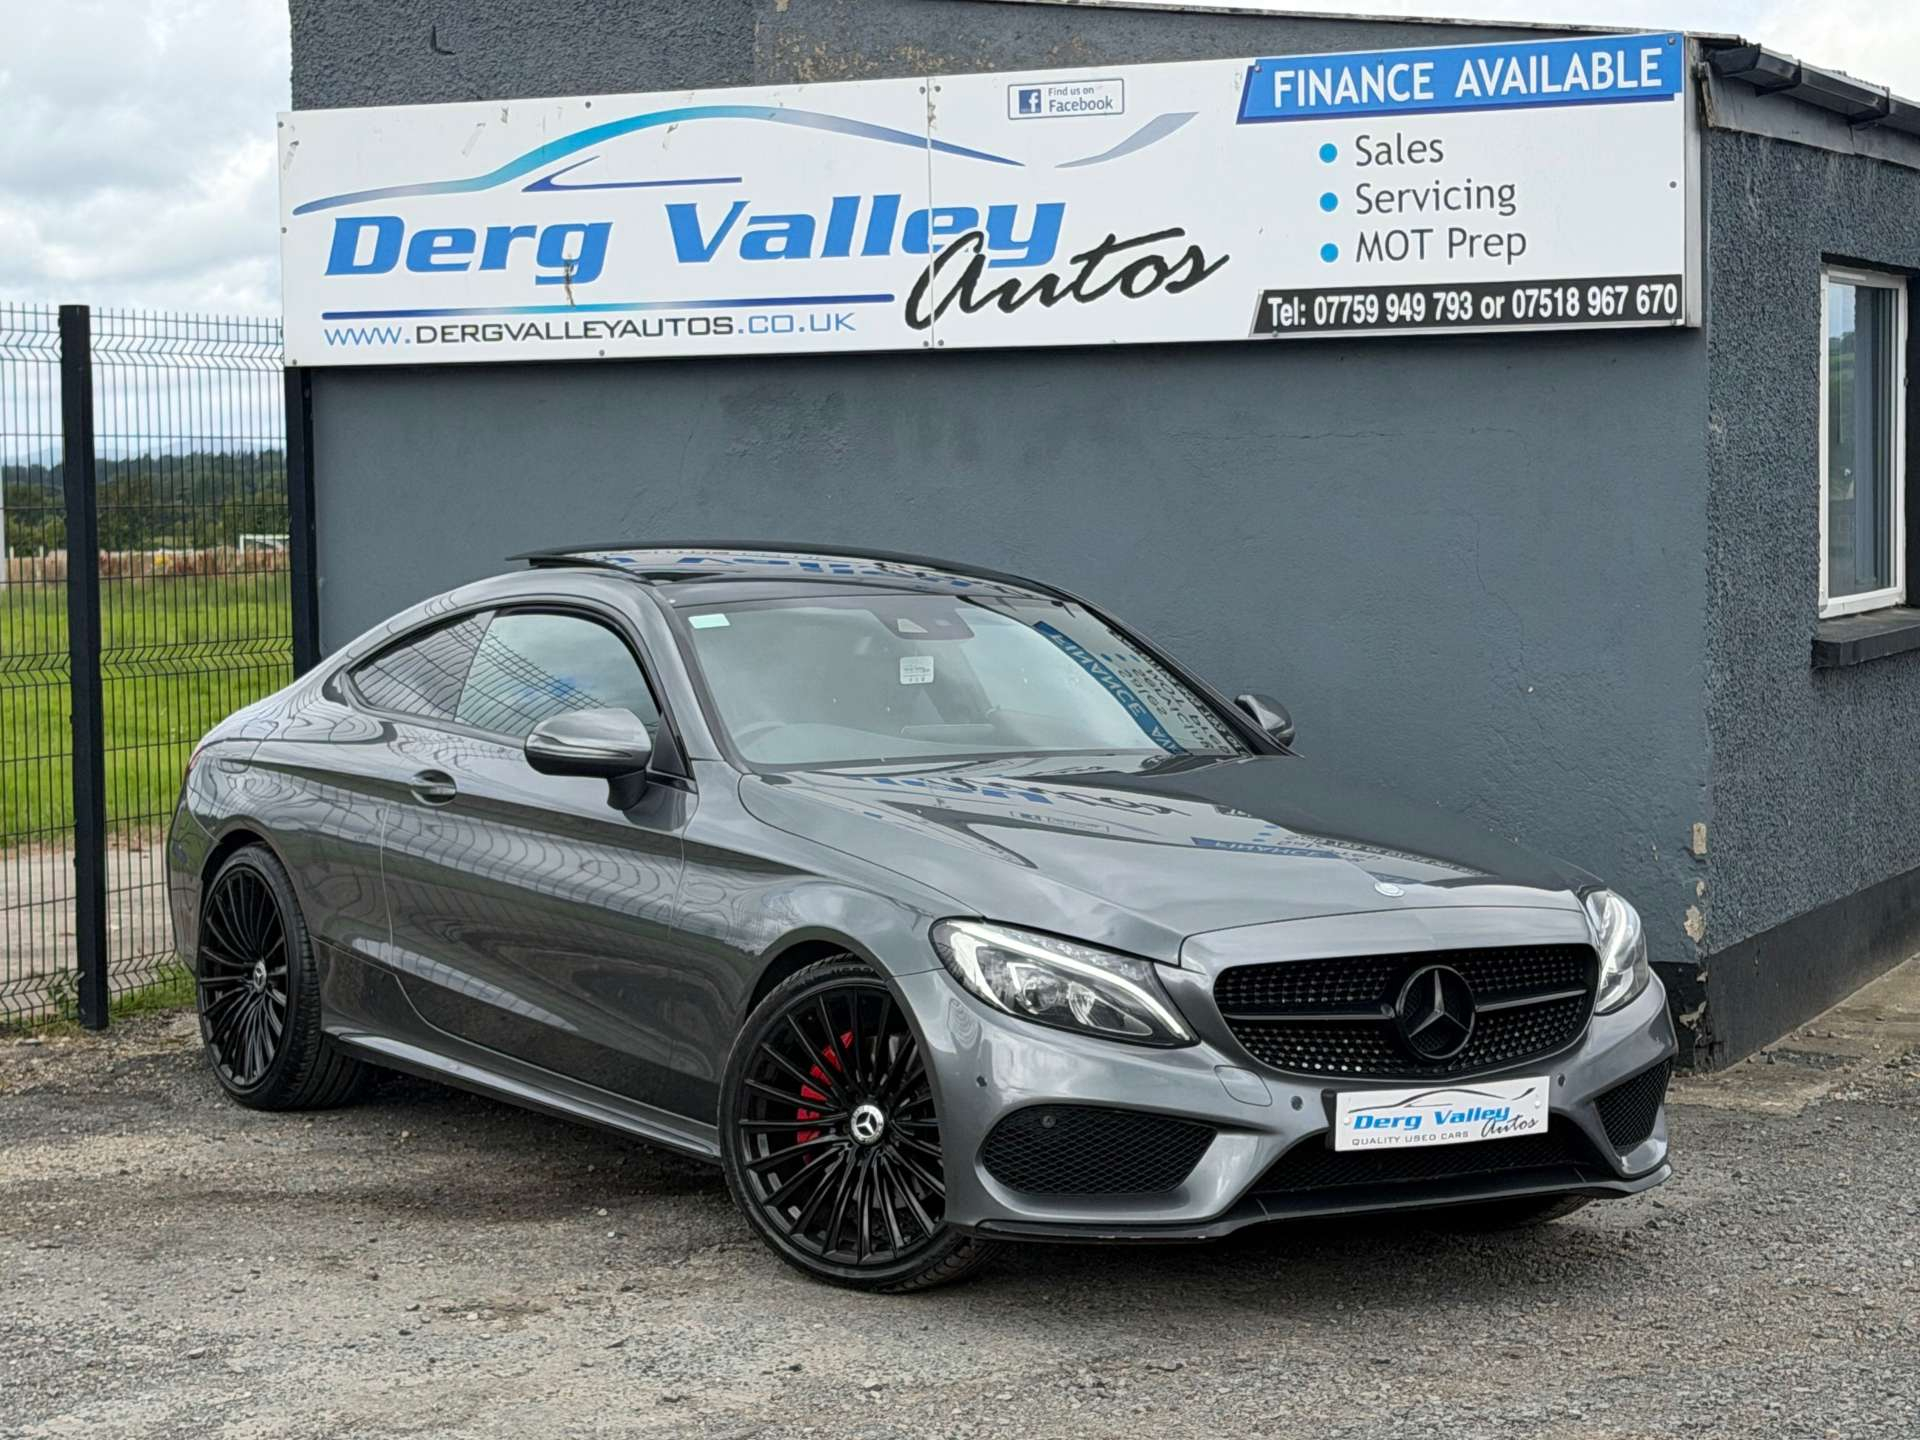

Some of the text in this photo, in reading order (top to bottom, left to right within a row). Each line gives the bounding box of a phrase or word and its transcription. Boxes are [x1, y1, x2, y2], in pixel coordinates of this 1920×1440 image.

[1048, 87, 1068, 96] Find
[1273, 48, 1663, 107] FINANCE AVAILABLE
[1049, 96, 1113, 112] Facebook
[1355, 132, 1444, 167] Sales
[1355, 178, 1517, 216] Servicing
[324, 194, 1066, 285] Derg Valley
[1355, 227, 1527, 265] MOT Prep
[904, 227, 1230, 330] Autos
[1267, 283, 1678, 327] Tel: 07759 949 793 or 07518 967 670
[1353, 1106, 1511, 1131] Derg Valley
[1481, 1115, 1539, 1138] Autos
[1352, 1131, 1469, 1146] QUALITY USED CARS
